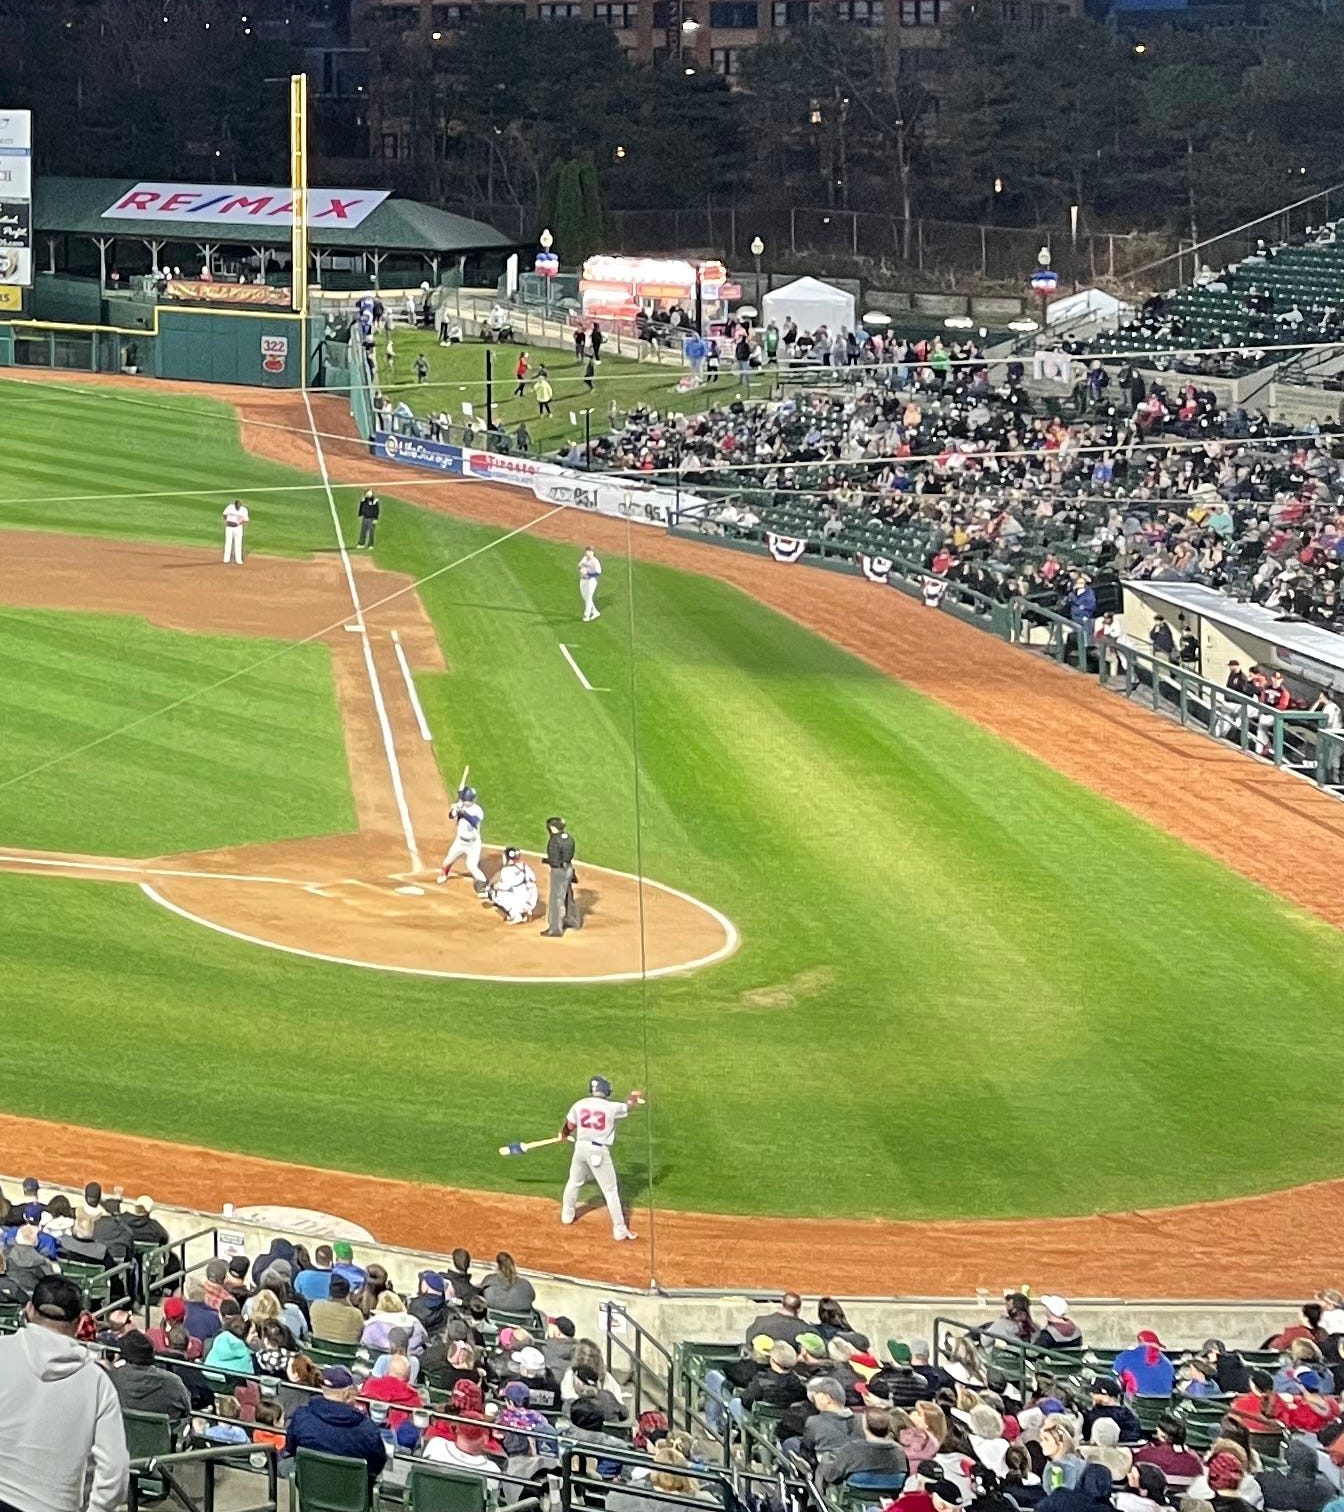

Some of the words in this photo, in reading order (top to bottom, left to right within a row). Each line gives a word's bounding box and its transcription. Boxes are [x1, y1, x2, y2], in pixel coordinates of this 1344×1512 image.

[117, 191, 365, 219] RE/MAX
[263, 341, 285, 353] 322
[580, 1108, 606, 1132] 23
